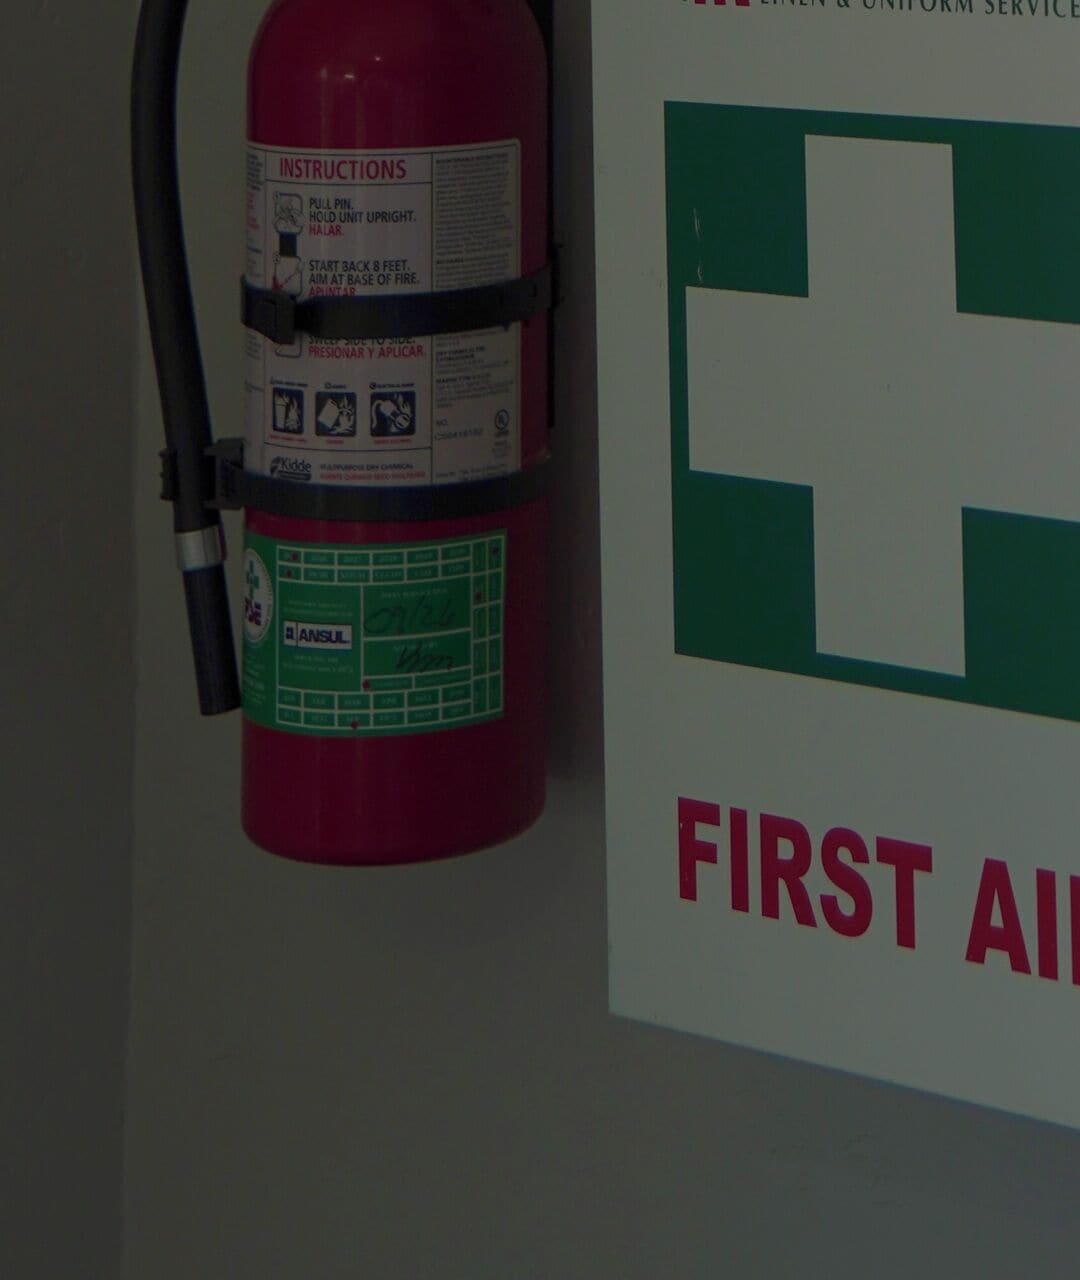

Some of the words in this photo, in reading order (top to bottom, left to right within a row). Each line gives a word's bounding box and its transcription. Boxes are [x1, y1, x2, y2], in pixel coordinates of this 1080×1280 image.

[280, 157, 407, 180] INSTRUCTIONS
[309, 197, 332, 210] PULL
[334, 197, 354, 210] PIN.
[309, 210, 336, 223] HOLD
[339, 210, 364, 223] UNIT
[366, 210, 417, 223] UPRIGHT.
[309, 223, 344, 236] HALAR.
[309, 260, 340, 272] START
[342, 260, 370, 272] BACK
[373, 260, 380, 272] 8
[383, 260, 410, 272] FEET.
[309, 272, 328, 285] AIM
[331, 273, 348, 285] AT
[348, 273, 374, 285] BASE
[377, 273, 392, 285] OF
[395, 272, 420, 285] FIRE.
[308, 345, 364, 359] PRESIONAR
[366, 345, 373, 358] Y
[281, 456, 311, 472] Kidde
[299, 628, 351, 644] ANSUL
[677, 796, 933, 949] FIRST
